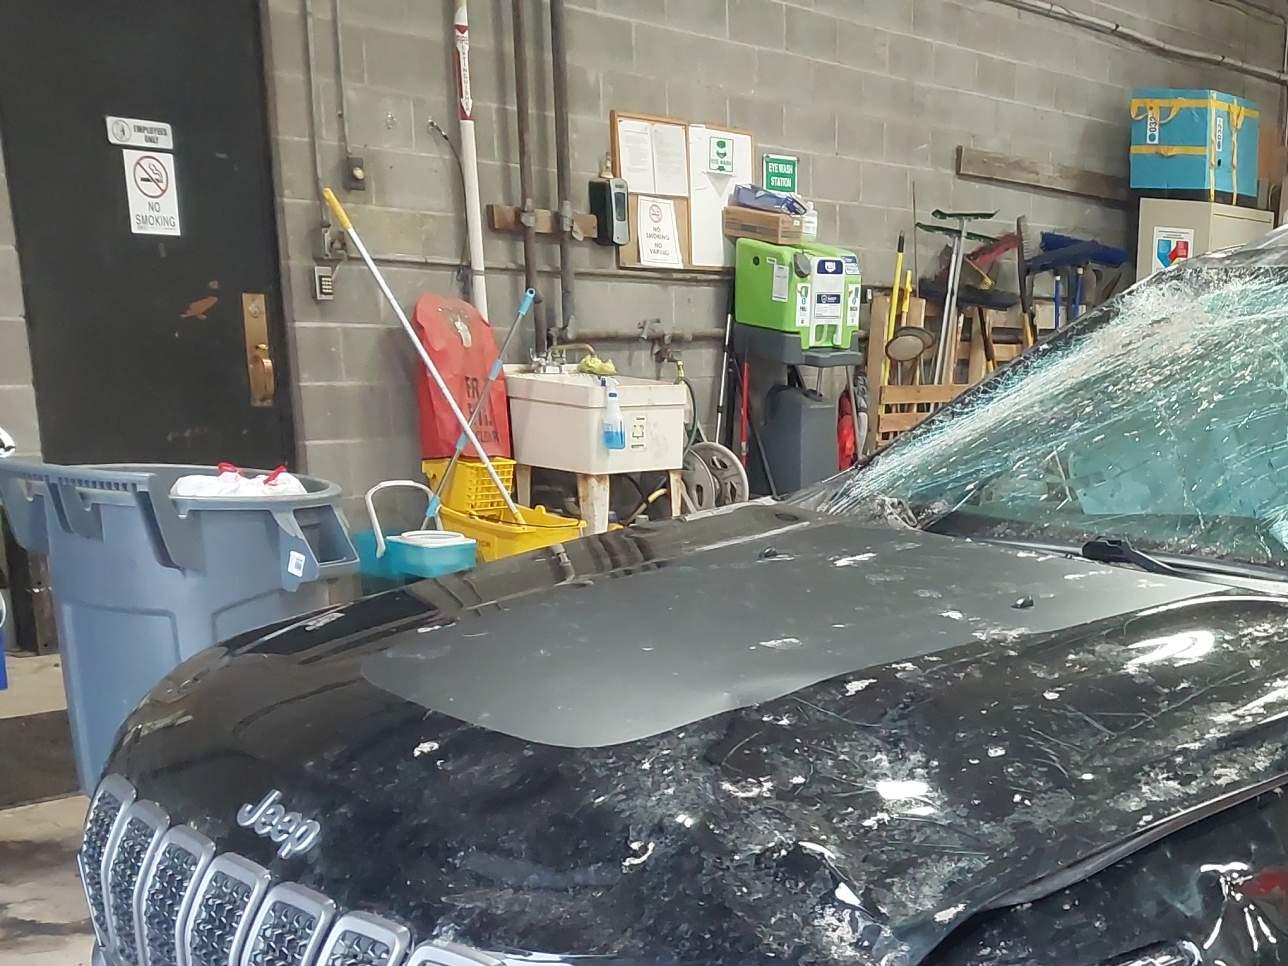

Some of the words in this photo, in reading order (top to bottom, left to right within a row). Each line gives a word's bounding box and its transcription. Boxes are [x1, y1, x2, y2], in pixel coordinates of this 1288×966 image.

[133, 125, 168, 136] EMPLOYEES
[144, 134, 159, 144] ONLY
[768, 162, 778, 173] EYE
[778, 163, 793, 174] WASH
[770, 176, 792, 187] STATION
[148, 201, 161, 212] NO
[135, 214, 176, 228] SMOKING
[645, 232, 670, 240] SMOKING
[237, 789, 320, 859] Jeep
